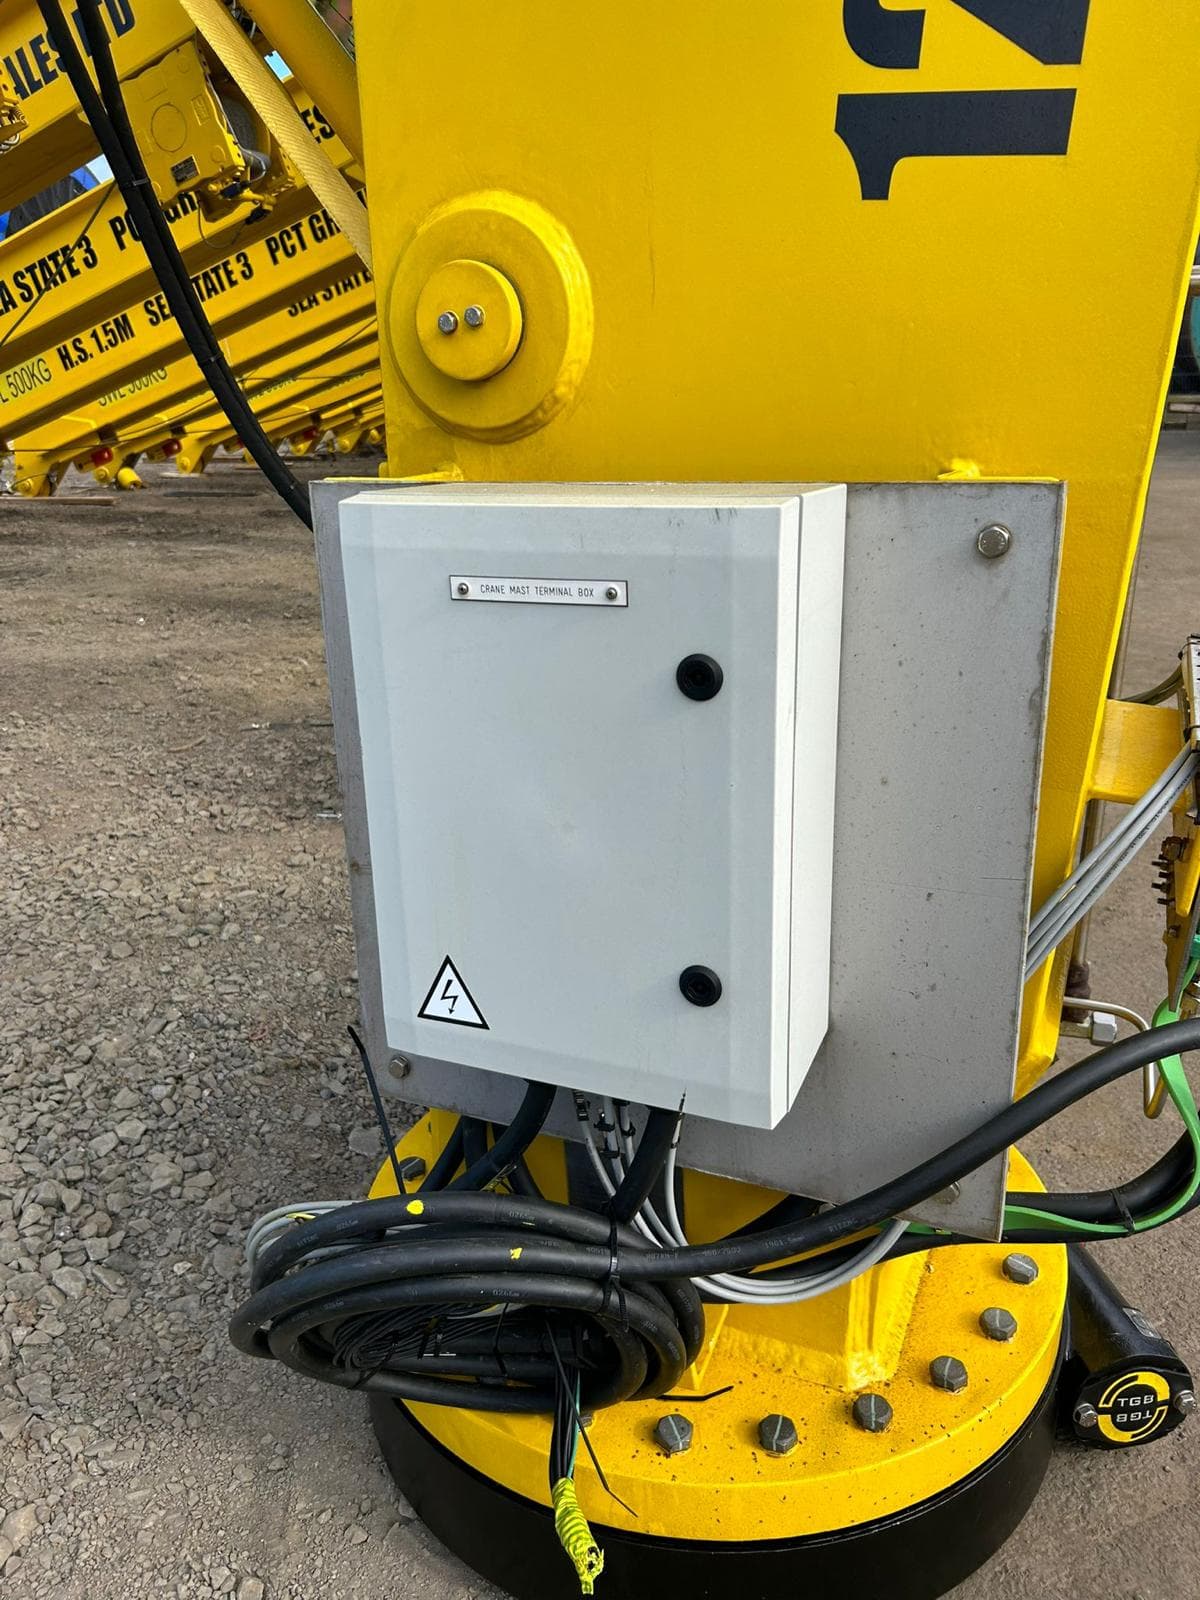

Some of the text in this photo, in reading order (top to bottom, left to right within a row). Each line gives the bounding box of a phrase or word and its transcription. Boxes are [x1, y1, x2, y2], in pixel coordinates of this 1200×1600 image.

[13, 244, 81, 303] STATE
[77, 234, 98, 270] 3
[6, 358, 52, 398] 500KG
[56, 344, 94, 372] H.S.
[90, 313, 136, 354] 1.5M
[236, 251, 254, 281] 3
[265, 221, 308, 266] PCT
[480, 584, 594, 598] CRANE MAST TERMINAL BOX
[1117, 1394, 1155, 1407] TGB
